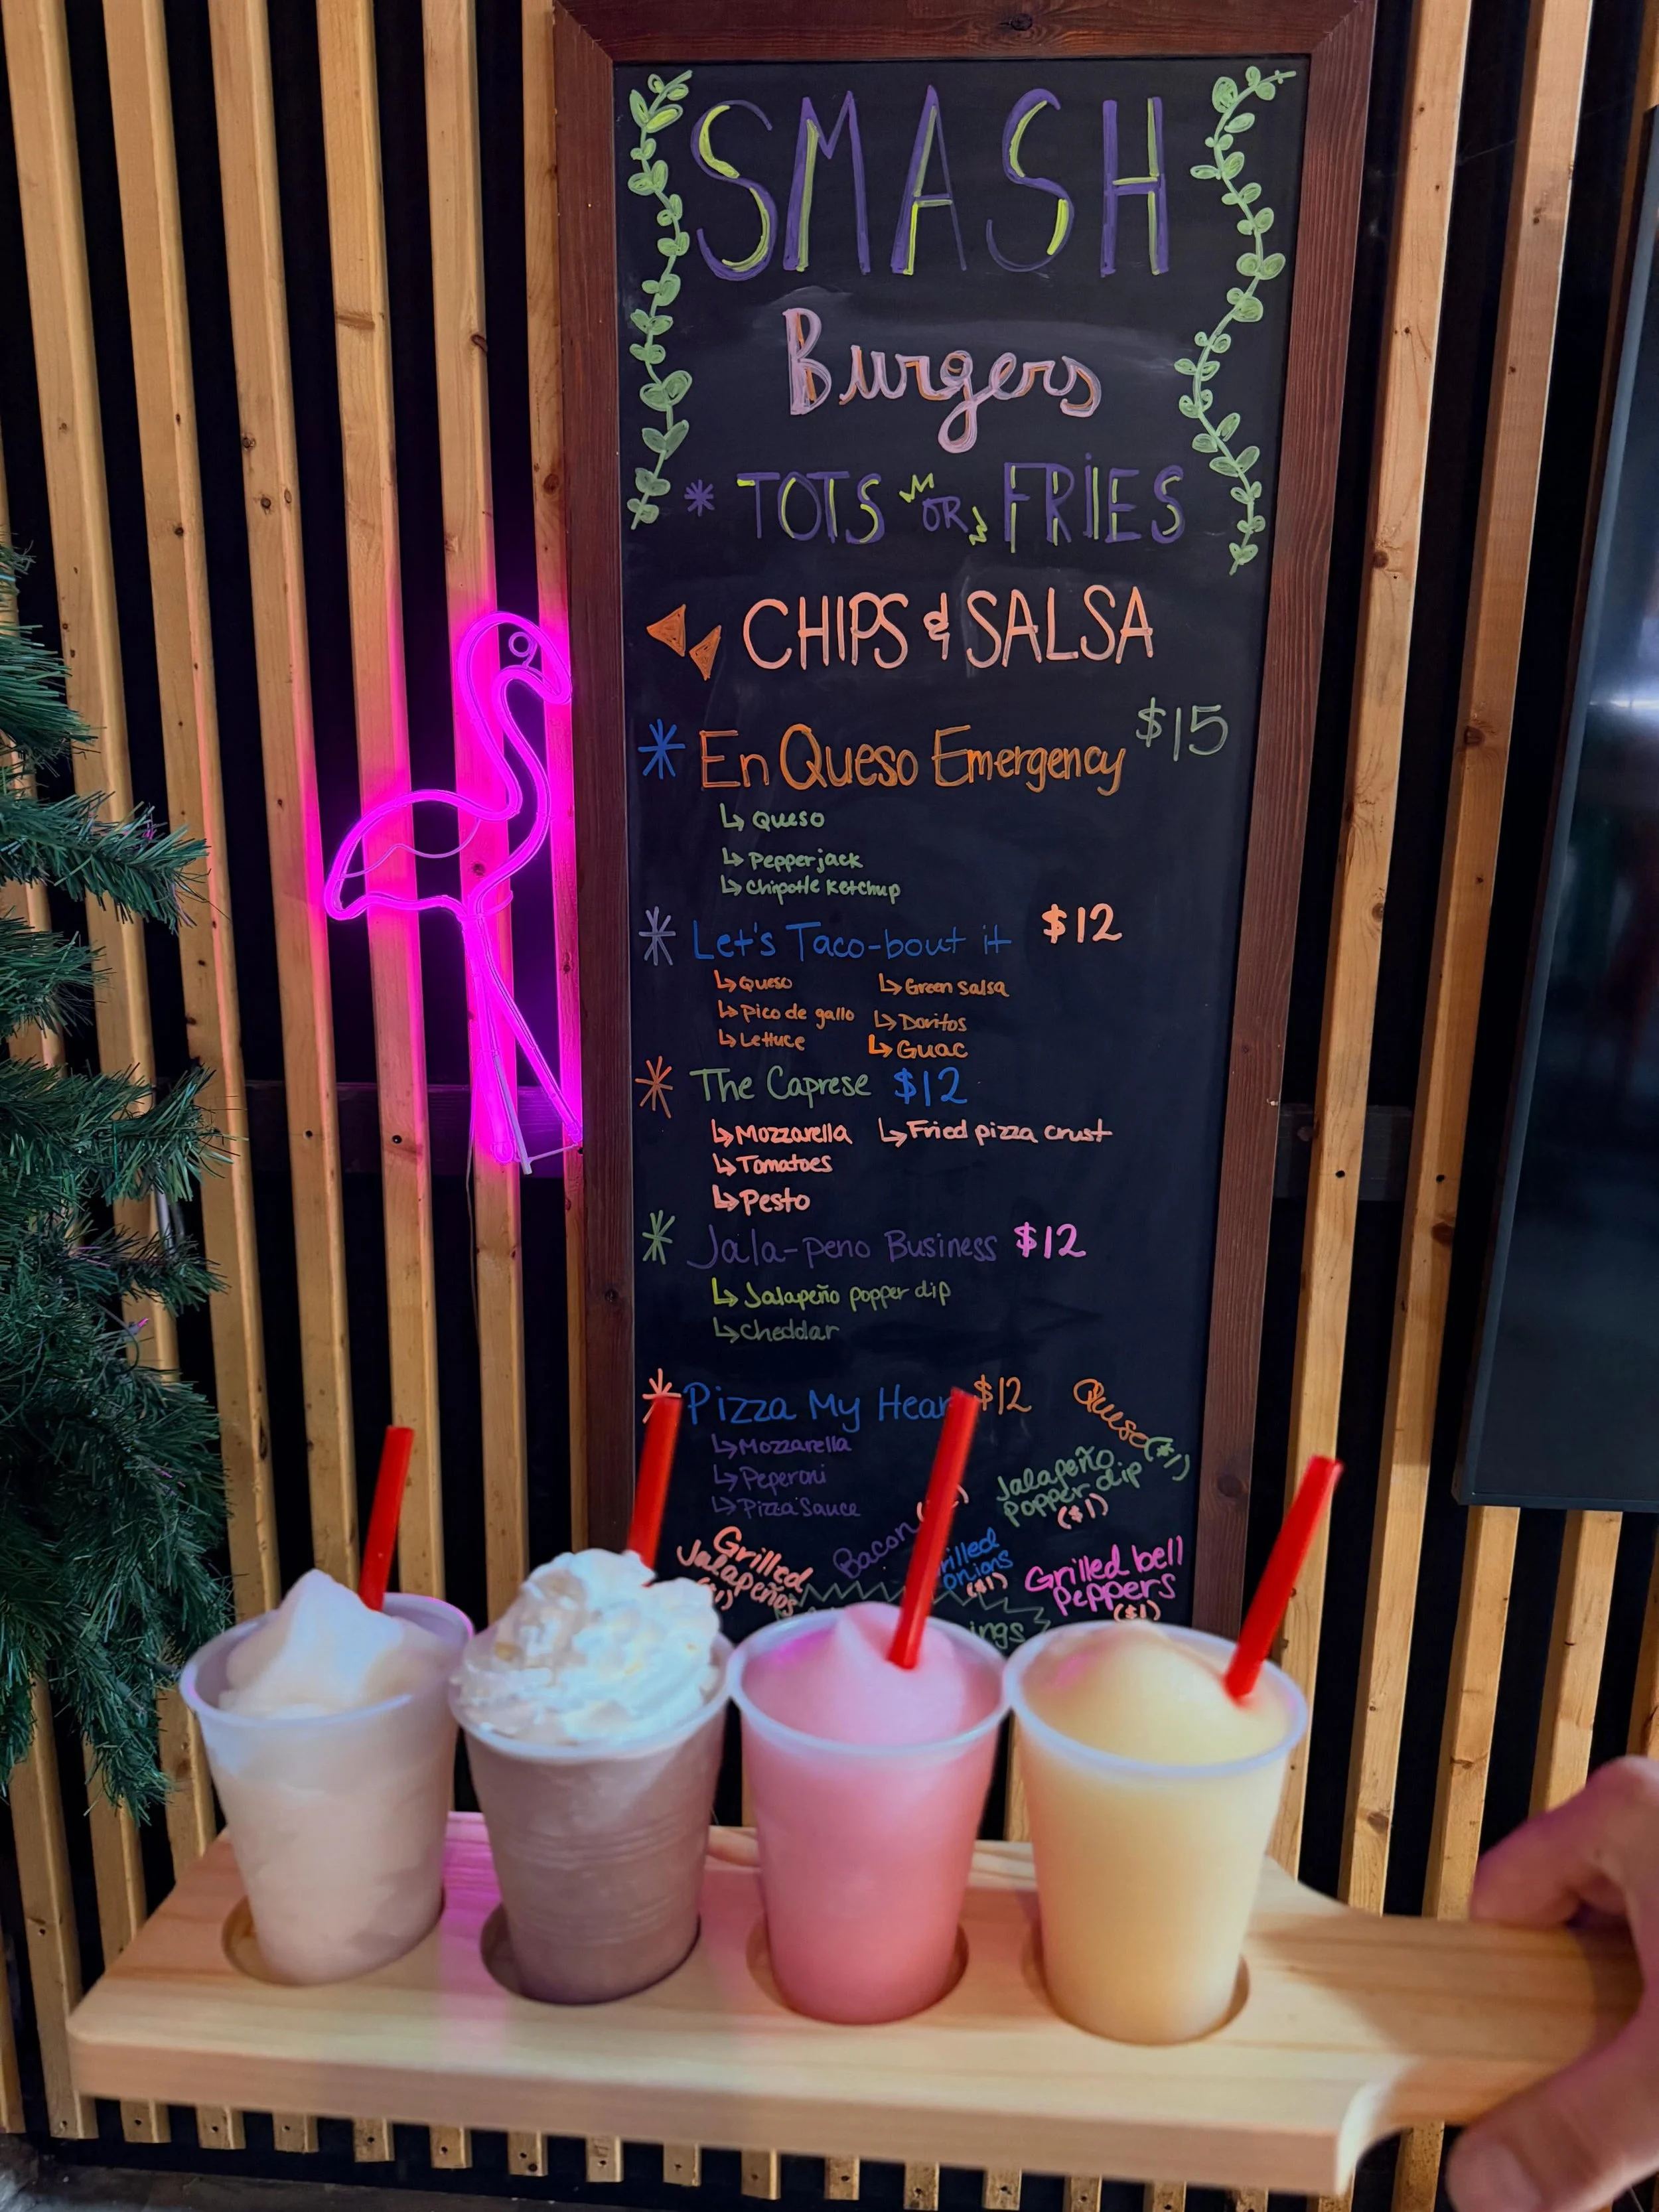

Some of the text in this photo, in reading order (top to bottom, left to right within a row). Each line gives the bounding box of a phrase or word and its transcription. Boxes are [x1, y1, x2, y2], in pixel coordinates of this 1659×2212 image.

[690, 84, 1169, 281] SMASH
[782, 307, 1102, 453] Burgers
[737, 470, 885, 544] TOTS
[922, 495, 968, 532] OR
[743, 591, 908, 669] CHIPS
[966, 585, 1153, 668] SALSA
[1135, 697, 1229, 762] $15
[699, 723, 1127, 796] En Queso Emergency
[752, 810, 826, 832] Queso
[745, 875, 820, 905] Chipotle
[692, 903, 1123, 961] Let's Taco-bout it $12
[739, 976, 793, 991] Queso
[904, 978, 953, 995] Green
[784, 1003, 807, 1020] de
[815, 1005, 855, 1030] gallo
[898, 1012, 968, 1033] Doritos
[740, 1031, 806, 1051] Lettuce
[897, 1039, 969, 1059] Guac
[690, 1065, 968, 1109] The Caprese $12
[736, 1124, 853, 1145] Mozzarella
[908, 1118, 1113, 1145] Fried pizza crust
[736, 1155, 833, 1173] Tomatoes
[739, 1187, 810, 1216] Pesto
[883, 1229, 997, 1262] Business
[1015, 1222, 1086, 1258] $12
[744, 1280, 952, 1312] Jalapeño popper dip
[739, 1318, 840, 1342] Cheddar
[683, 1374, 1033, 1433] Pizza My Hear $12
[1073, 1378, 1149, 1449] Queso
[738, 1436, 852, 1455] Mozzarella
[739, 1463, 826, 1496] Peperoni
[996, 1445, 1115, 1501] Jalapeño
[1096, 1461, 1143, 1492] dip
[737, 1497, 861, 1519] Pizza Sauce
[713, 1526, 814, 1593] Grilled
[833, 1521, 922, 1579] Bacon
[937, 1526, 999, 1576] rilled
[1024, 1535, 1184, 1592] Grilled bell
[676, 1538, 798, 1617] Jalapeños
[970, 1621, 1026, 1650] ings
